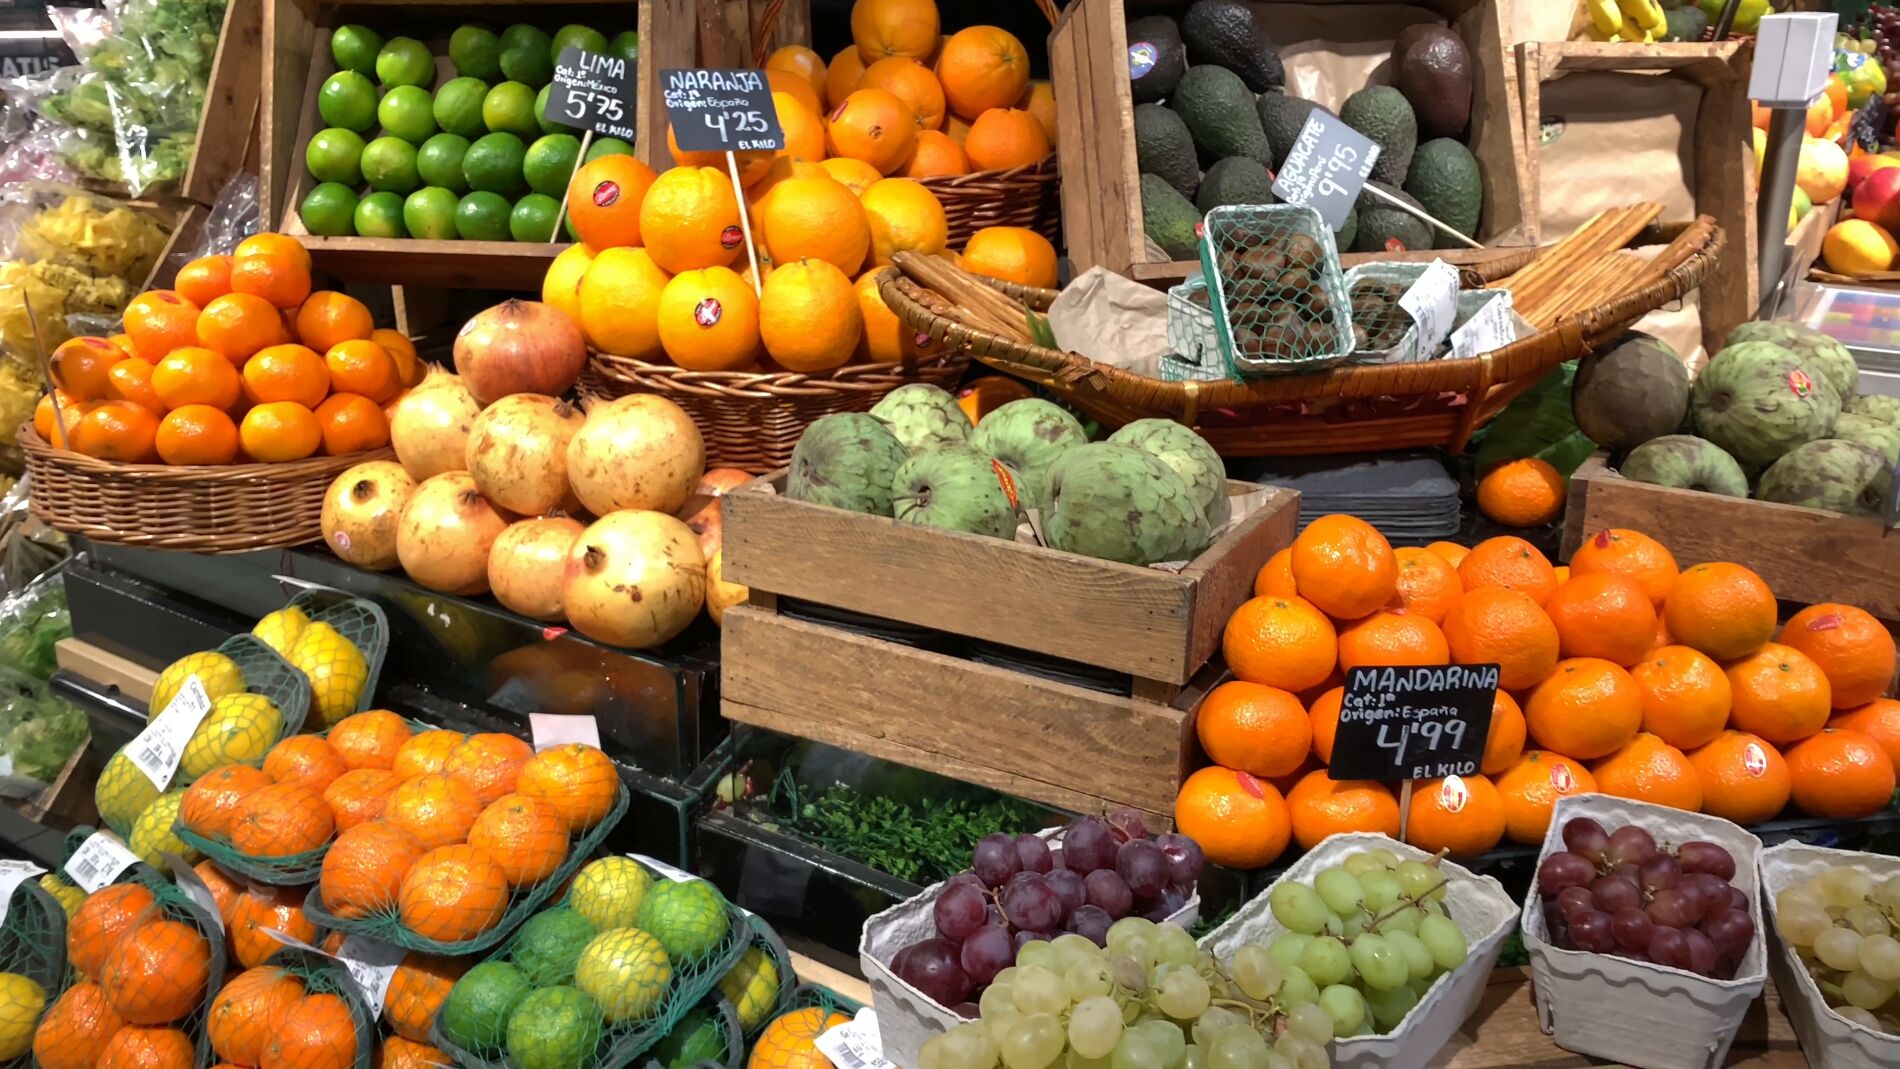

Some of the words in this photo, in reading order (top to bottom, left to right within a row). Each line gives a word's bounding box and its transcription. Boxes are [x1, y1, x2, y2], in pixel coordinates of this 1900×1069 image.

[580, 50, 625, 80] LIMA
[669, 70, 763, 93] NARANJA
[564, 89, 624, 121] 5'75
[595, 122, 607, 133] EL
[608, 124, 634, 139] KILO
[704, 110, 769, 143] 4'25
[738, 140, 749, 150] EL
[751, 139, 776, 149] KILO
[1277, 117, 1325, 193] AGUACATE
[1318, 143, 1358, 196] 9'95
[1353, 666, 1498, 692] MANDARINA
[1376, 719, 1467, 766] 4'99
[1413, 766, 1432, 779] EL
[1437, 760, 1475, 776] KILO
